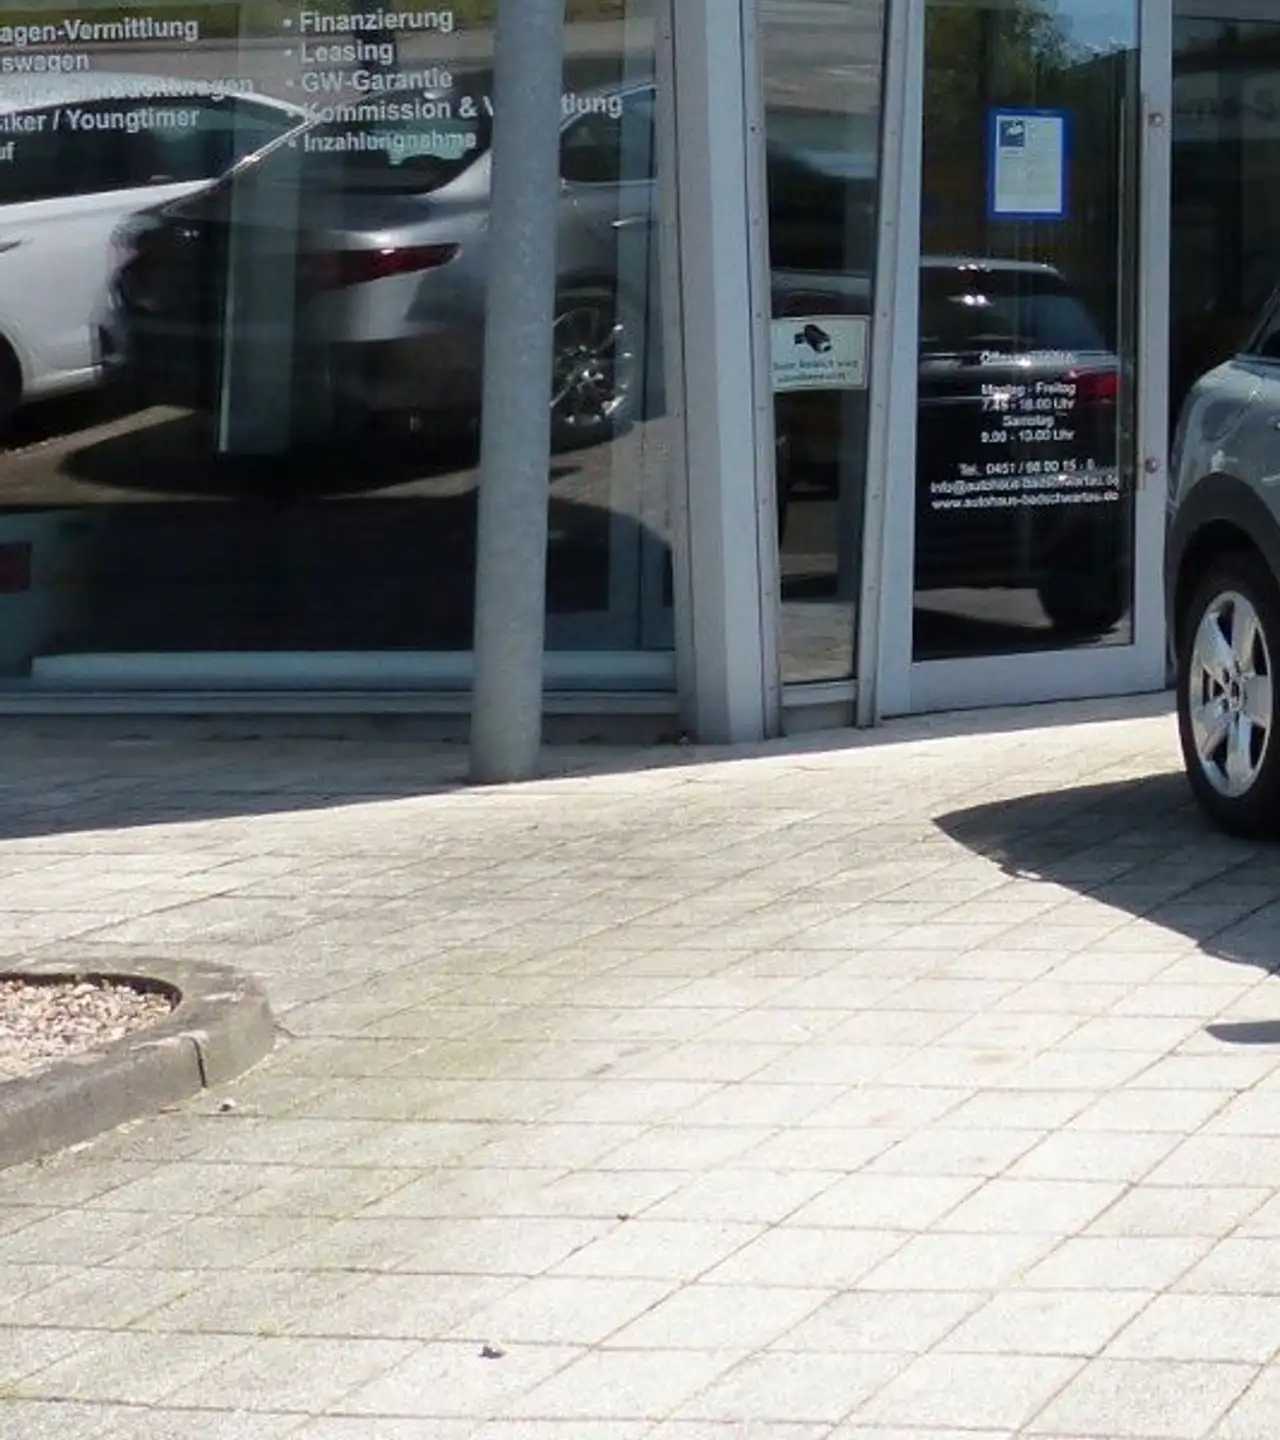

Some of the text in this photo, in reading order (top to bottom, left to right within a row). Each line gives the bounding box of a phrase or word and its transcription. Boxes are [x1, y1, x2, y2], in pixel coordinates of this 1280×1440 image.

[300, 8, 454, 32] Finanzierung
[301, 39, 393, 64] Leasing
[302, 68, 454, 92] GW-Garantie
[65, 109, 200, 133] Youngtimer
[303, 98, 451, 124] Kommission
[457, 97, 478, 117] &
[303, 130, 477, 153] Inzahlungnahme
[1036, 381, 1077, 397] Freitag
[1054, 397, 1076, 409] Uhr
[1003, 414, 1055, 428] Samstag
[1053, 429, 1076, 440] Uhr
[986, 462, 1015, 474] 0451
